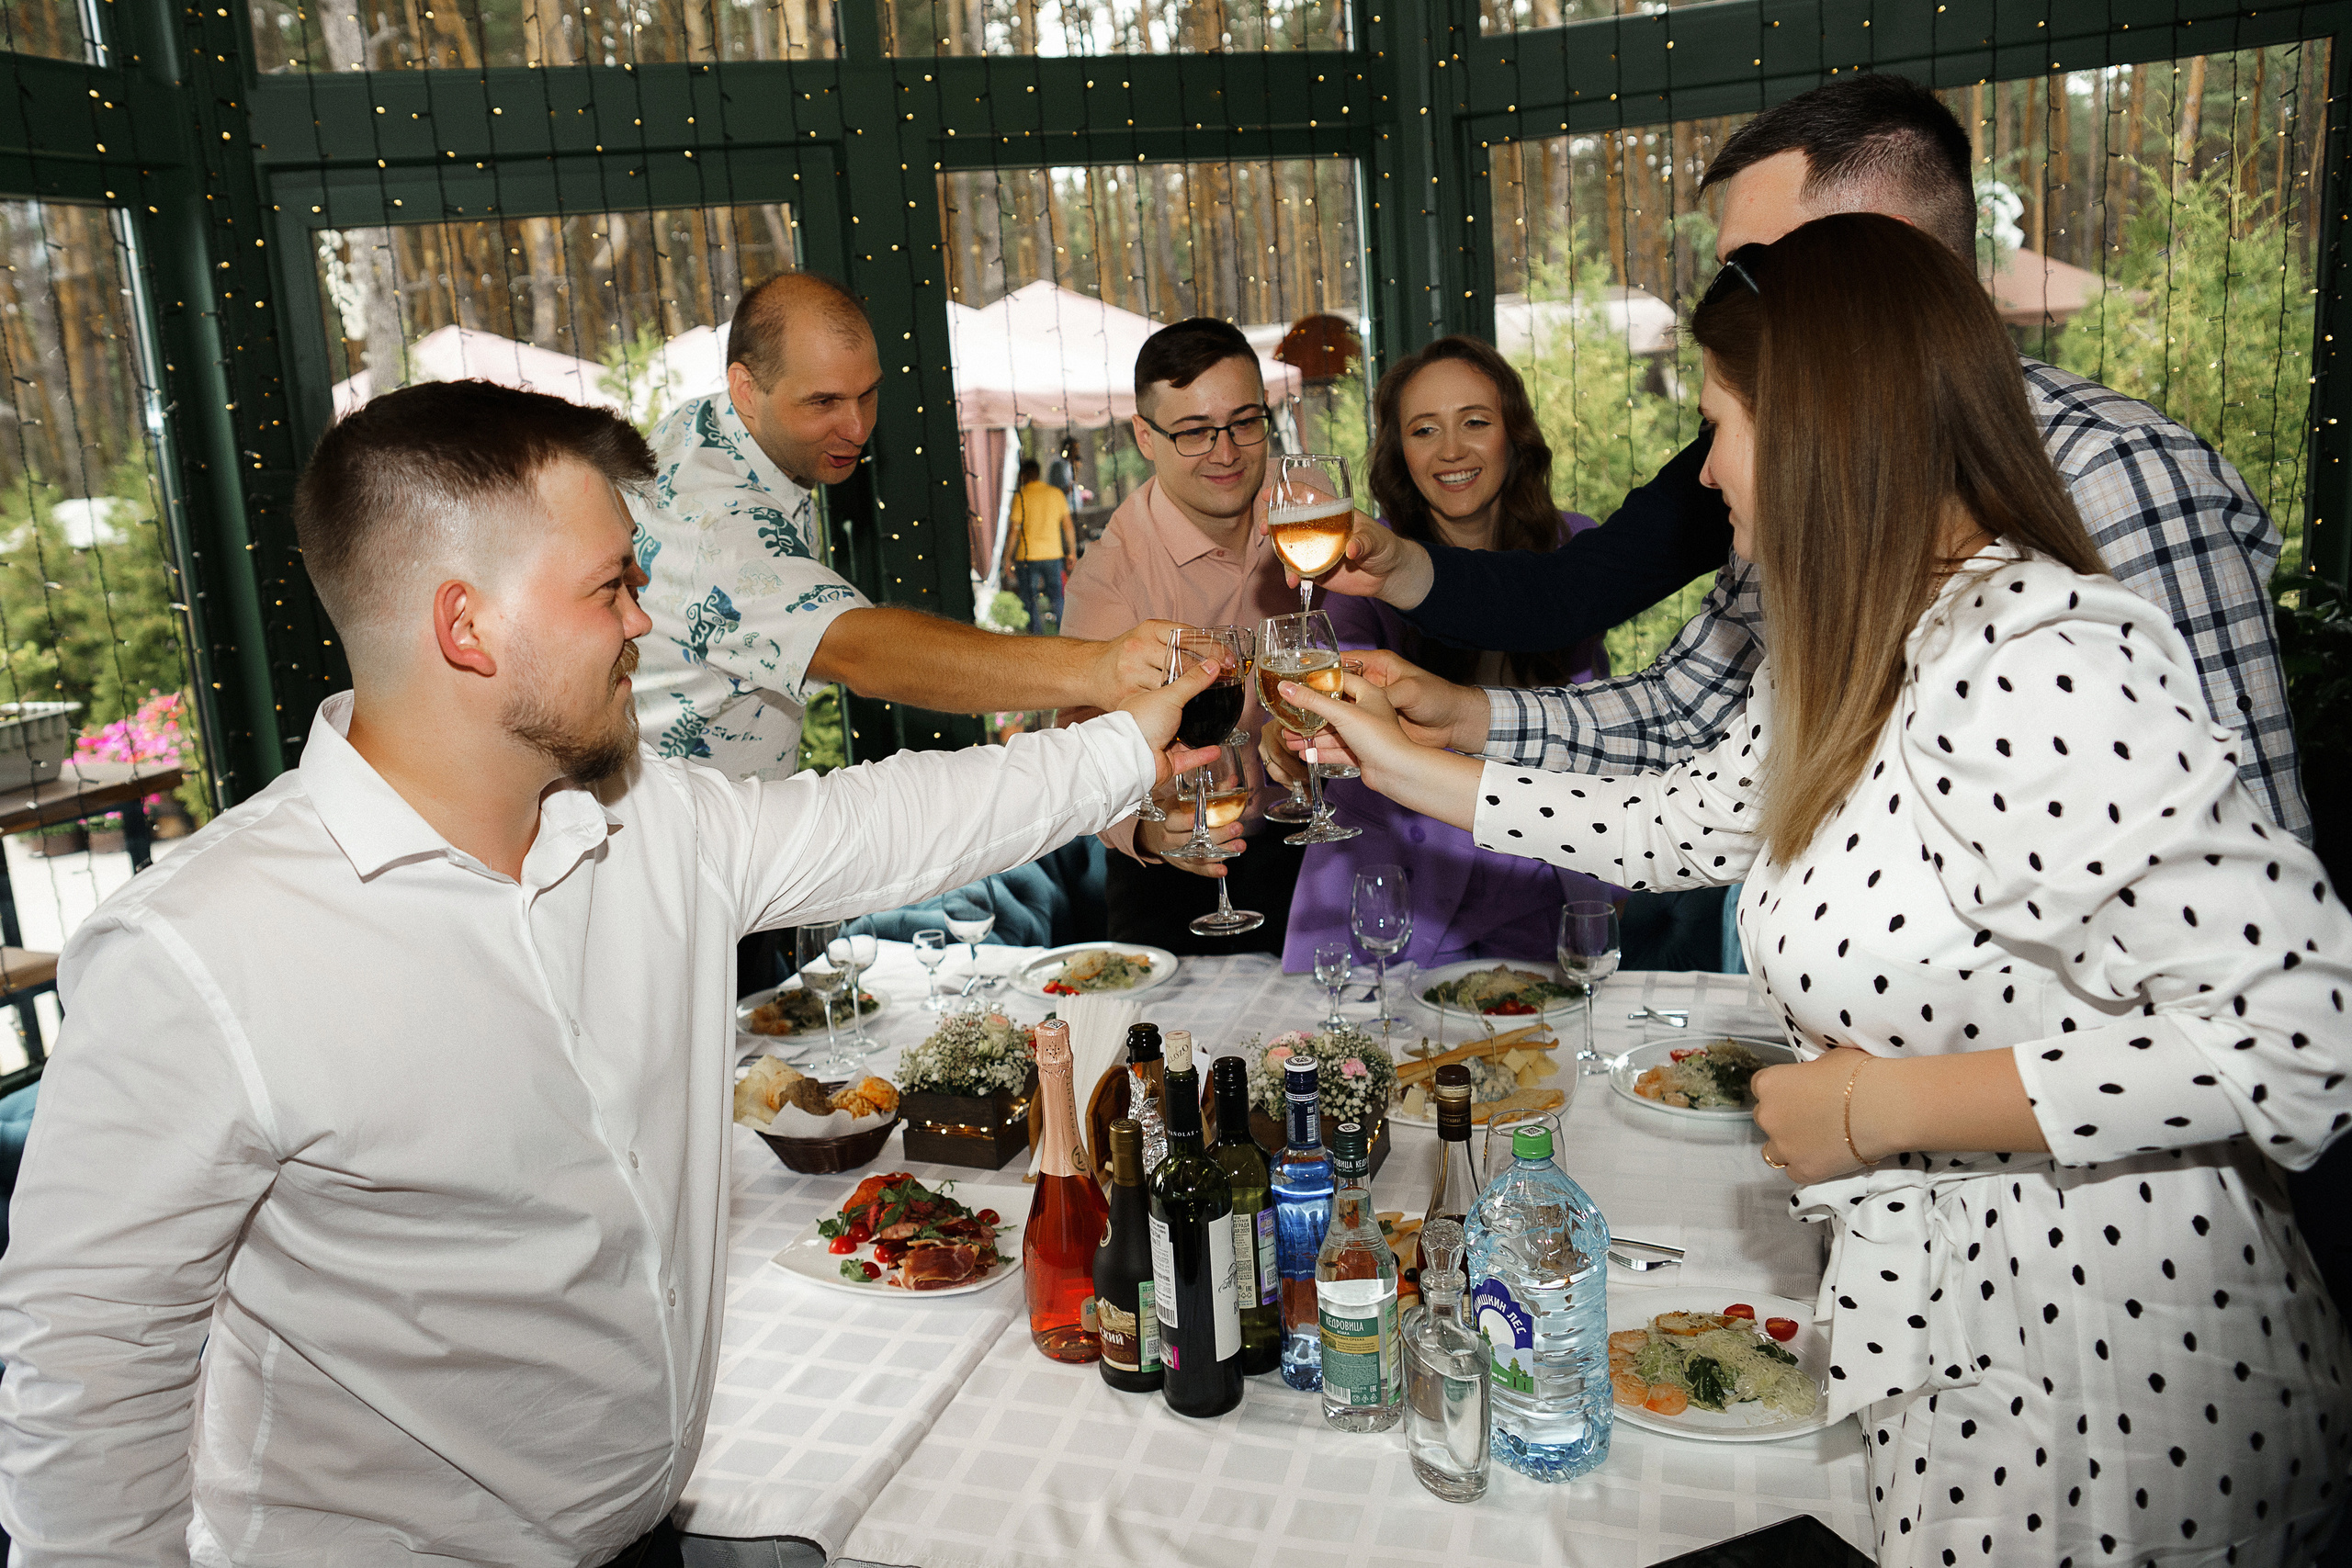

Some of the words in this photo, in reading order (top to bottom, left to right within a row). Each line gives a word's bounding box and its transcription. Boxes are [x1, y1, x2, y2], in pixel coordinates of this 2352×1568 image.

[1325, 1314, 1364, 1332] КЕДРОВИЦА
[1474, 1293, 1507, 1314] ШИШКИН
[1507, 1312, 1527, 1335] ЛЕС
